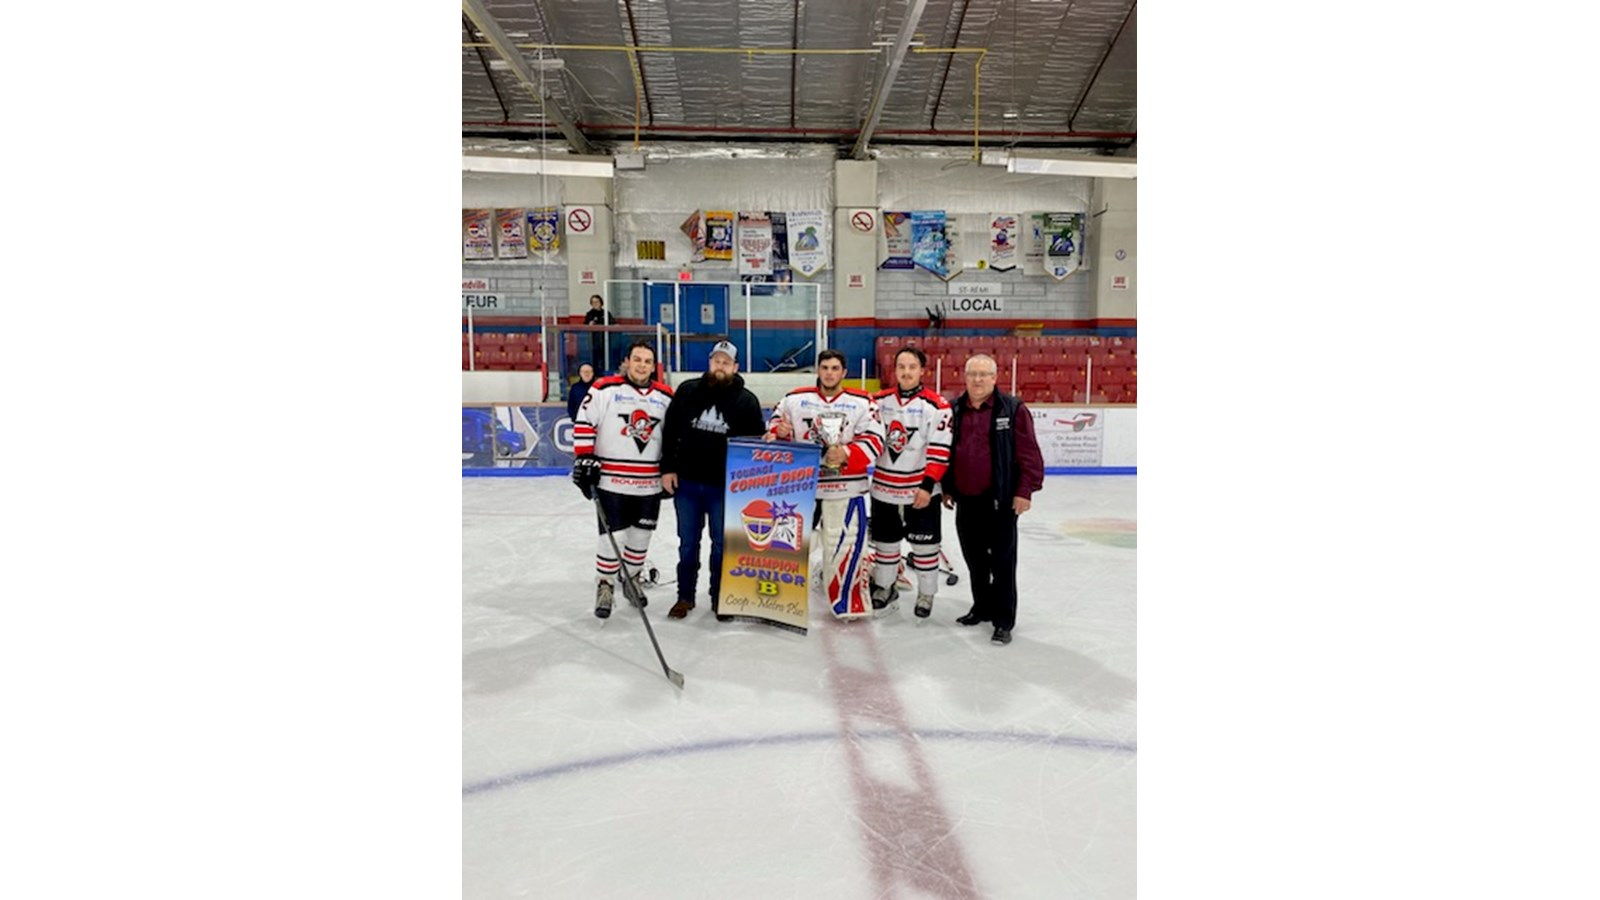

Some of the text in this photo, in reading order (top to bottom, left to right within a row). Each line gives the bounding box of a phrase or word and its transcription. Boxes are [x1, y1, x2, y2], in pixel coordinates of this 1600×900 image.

[952, 298, 1002, 311] LOCAL
[752, 449, 794, 465] 2023
[729, 466, 815, 493] CONNIE DION
[737, 554, 800, 573] CHAMPION
[729, 566, 806, 587] JUNIOR
[757, 579, 779, 596] B
